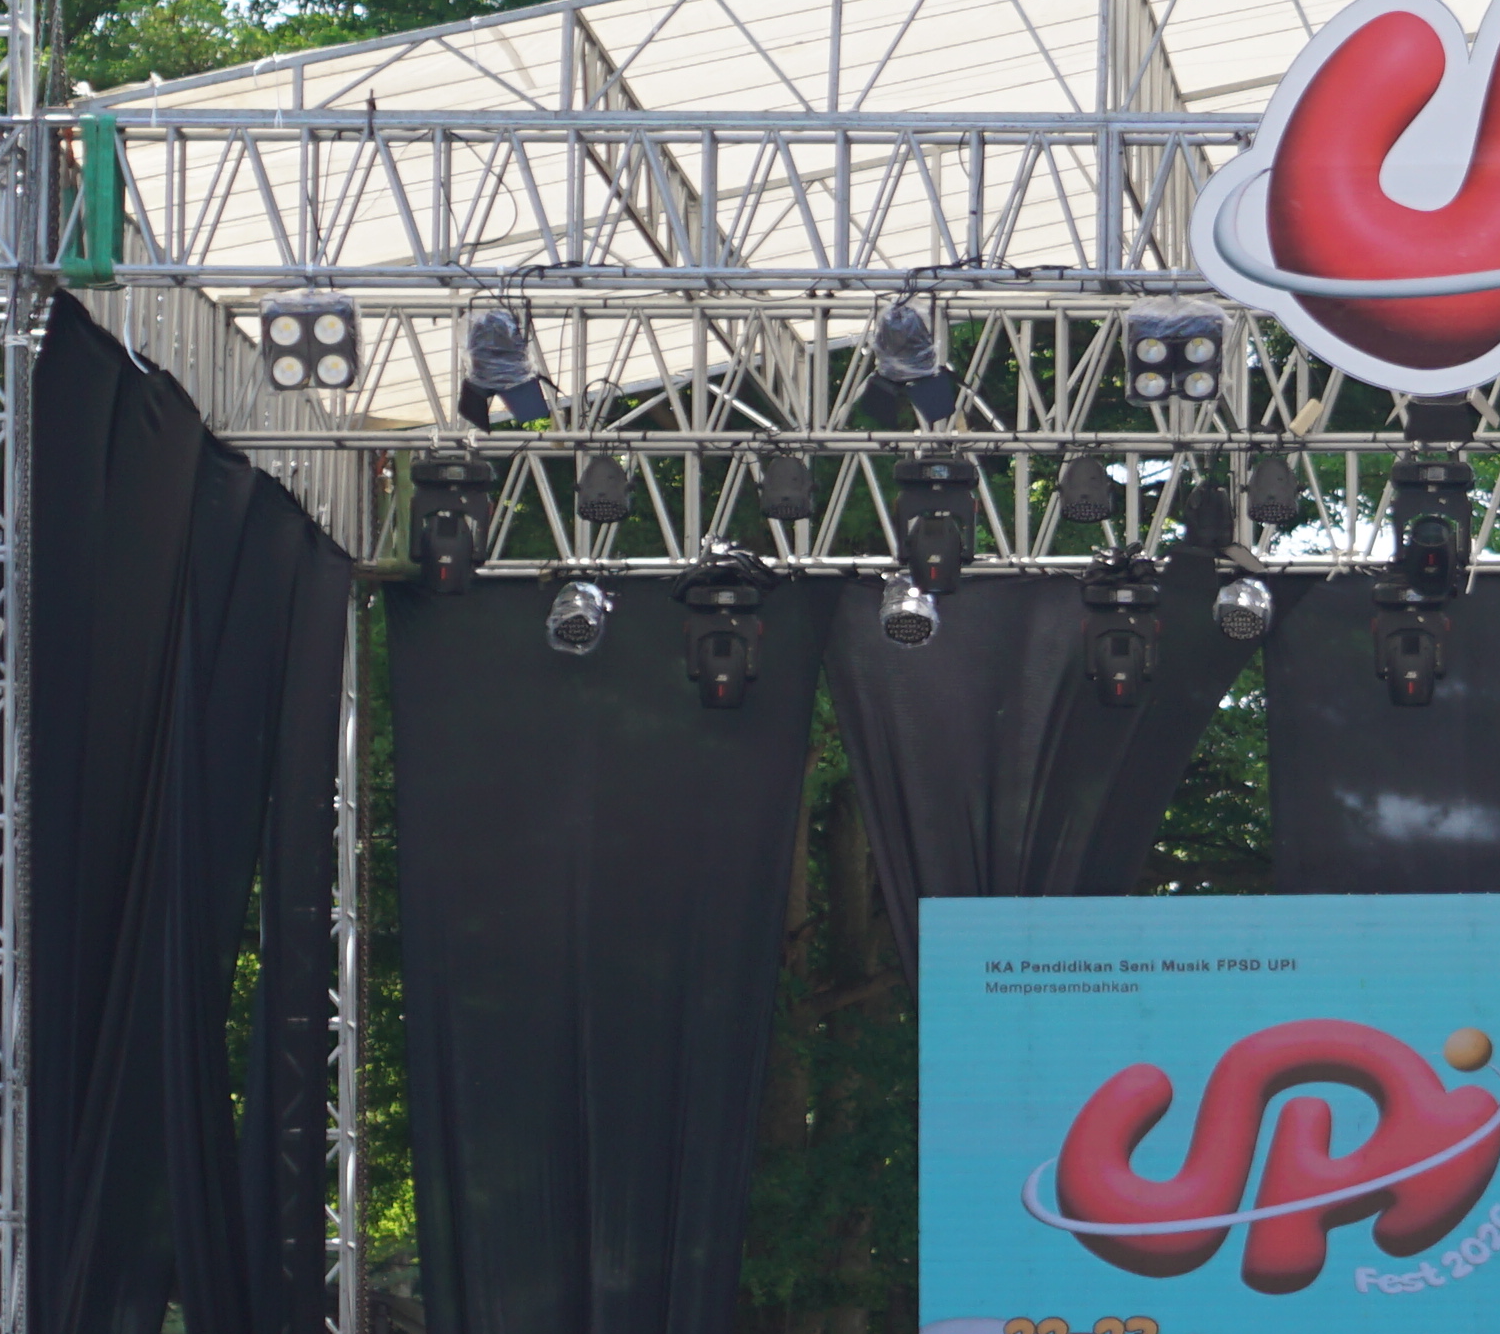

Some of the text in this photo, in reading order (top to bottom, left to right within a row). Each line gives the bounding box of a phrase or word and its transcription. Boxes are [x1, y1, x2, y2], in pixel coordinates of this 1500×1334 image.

[985, 958, 1296, 973] IKA Pendidikan Seni Musik FPSD UPI
[985, 980, 1140, 996] Mempersembahkan
[1355, 1262, 1447, 1294] Fest
